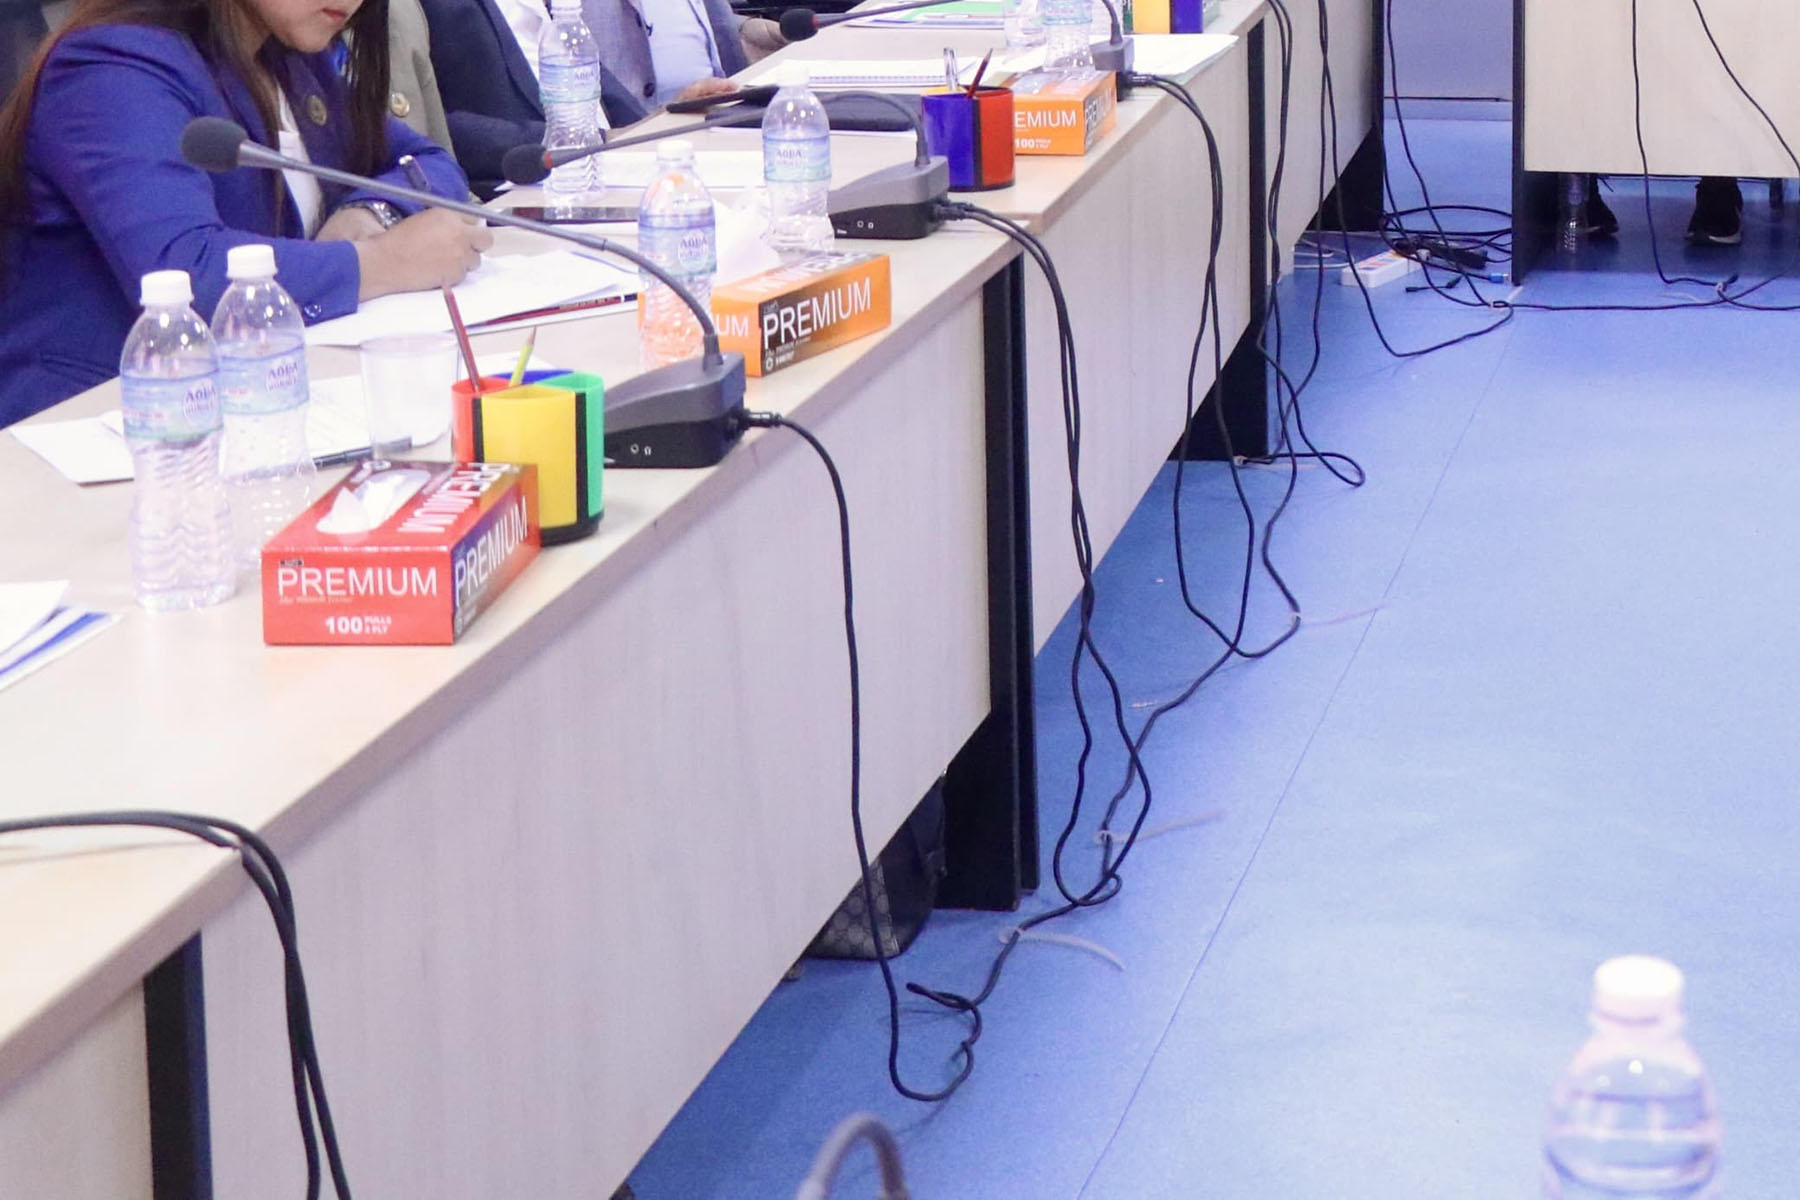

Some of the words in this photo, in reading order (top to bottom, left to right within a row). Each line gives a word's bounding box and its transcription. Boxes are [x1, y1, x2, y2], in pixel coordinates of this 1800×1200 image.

[1014, 110, 1077, 128] EMIUM
[763, 277, 872, 349] PREMIUM
[455, 495, 528, 608] PREMIUM
[277, 567, 438, 598] PREMIUM
[325, 616, 364, 635] 100
